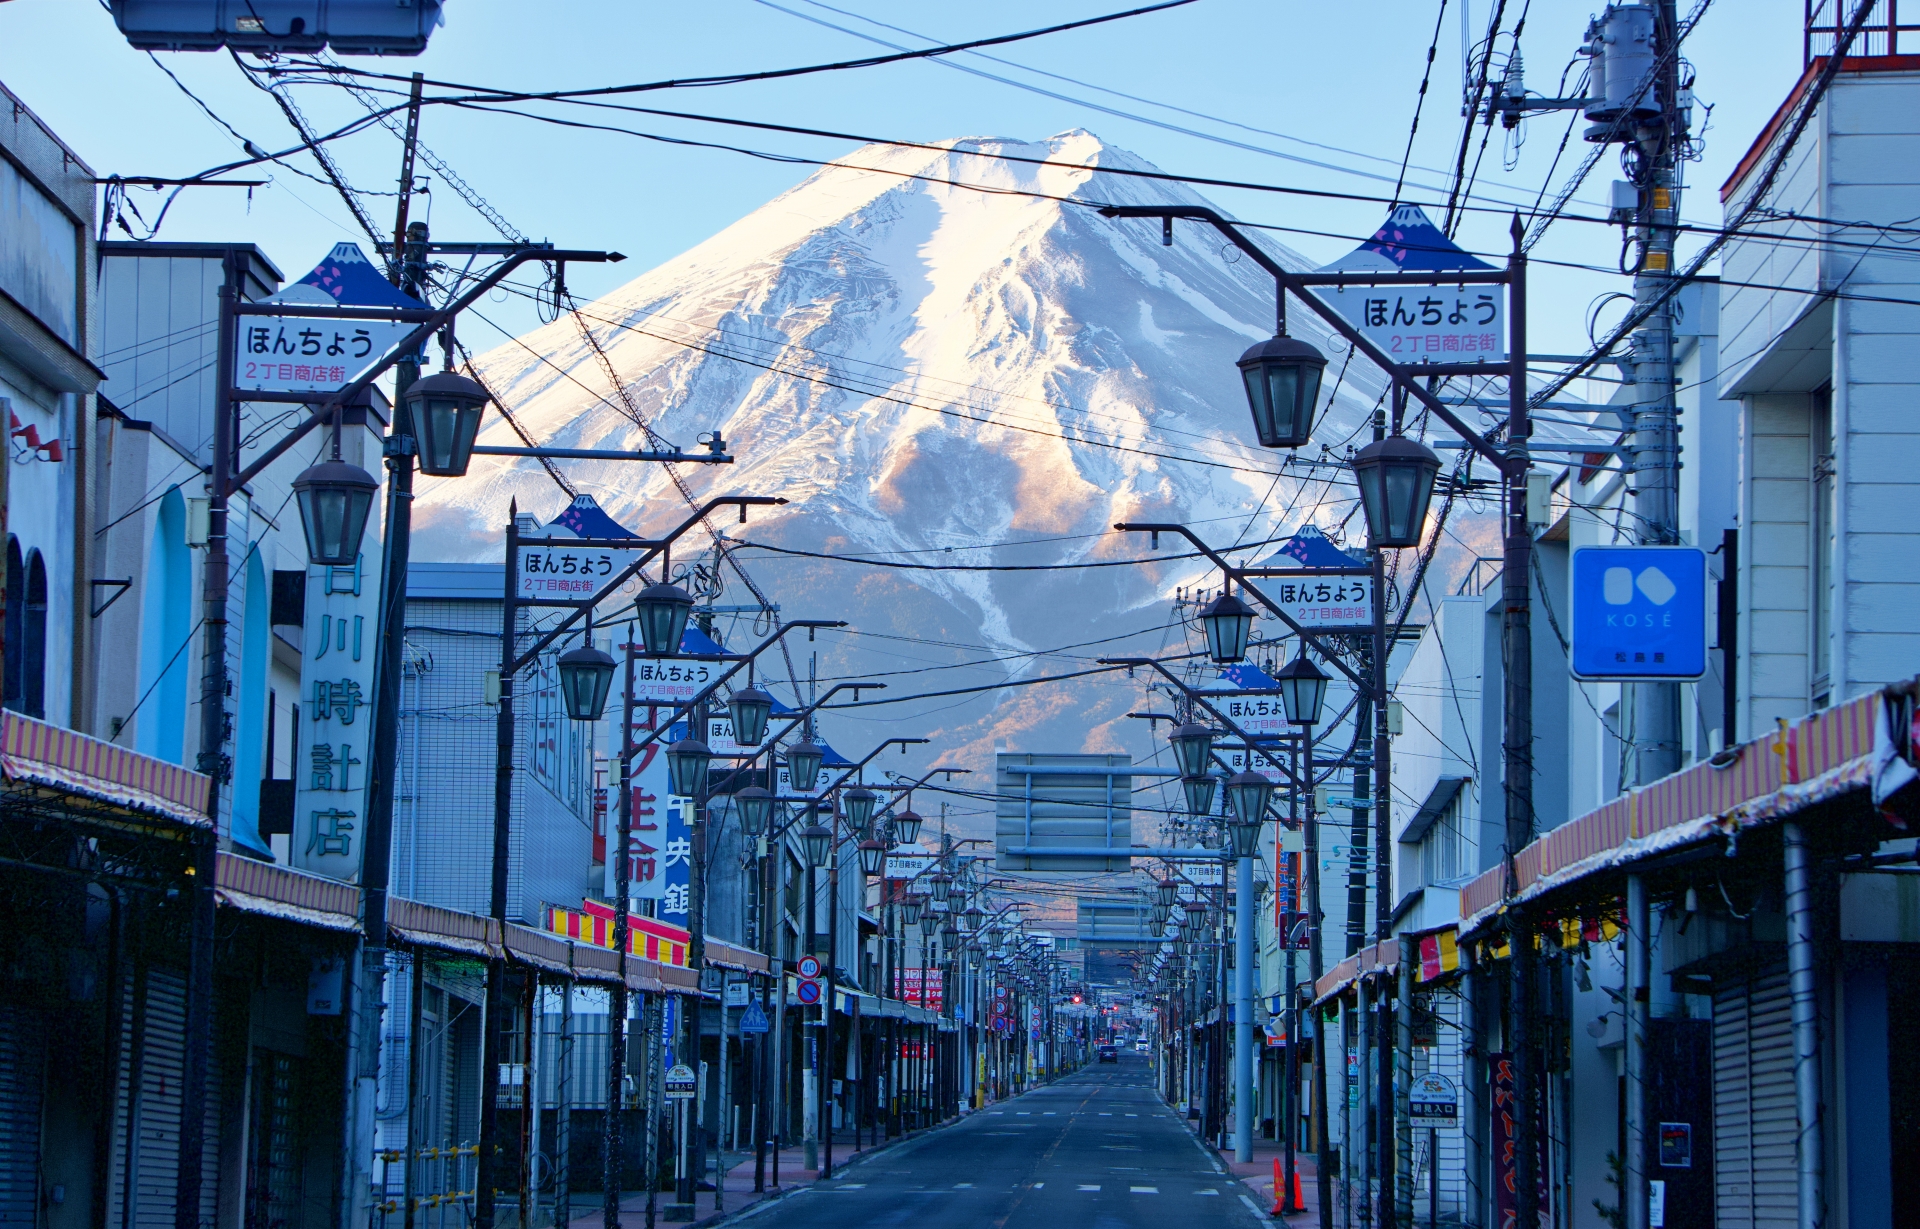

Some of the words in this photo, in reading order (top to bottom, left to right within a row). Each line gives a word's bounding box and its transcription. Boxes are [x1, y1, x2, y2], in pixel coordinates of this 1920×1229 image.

[1364, 294, 1496, 327] ほんちょう
[247, 326, 372, 358] ほんちょう
[1390, 333, 1496, 353] 2丁目商店街
[245, 361, 346, 383] 2丁目商店街
[525, 553, 612, 576] ほんちょう
[524, 578, 594, 592] 2丁目商店街
[1280, 581, 1366, 604] ほんちょう
[1298, 606, 1366, 620] 2丁目商店街
[1606, 610, 1672, 628] KOSÉ
[640, 664, 710, 684] ほんちょう
[639, 684, 695, 696] 2丁目商店街
[1229, 700, 1282, 717] ほんちょ
[711, 722, 770, 737] ほんう
[802, 962, 817, 973] 40
